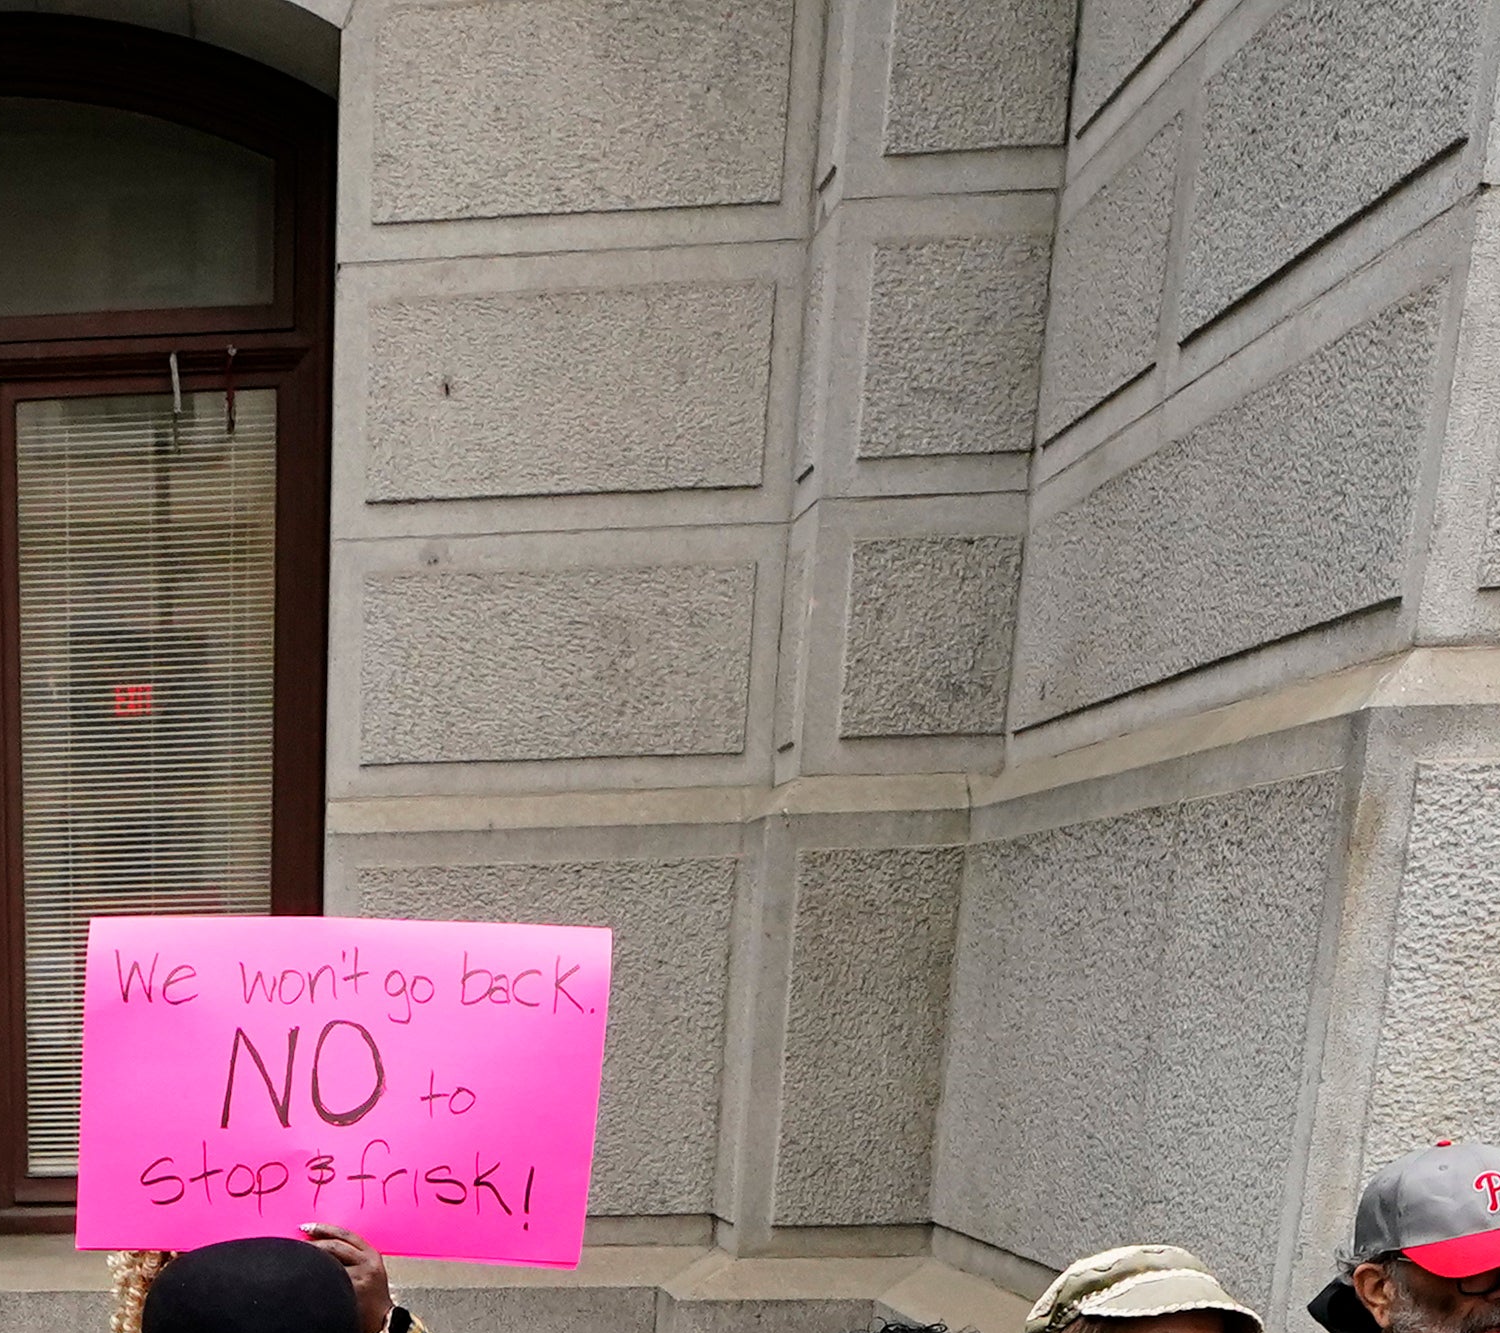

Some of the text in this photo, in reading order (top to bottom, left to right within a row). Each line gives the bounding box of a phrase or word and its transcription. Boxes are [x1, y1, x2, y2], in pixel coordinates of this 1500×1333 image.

[115, 949, 199, 1006] We
[239, 946, 368, 1006] won't
[383, 965, 436, 1024] go
[220, 1019, 476, 1130] NO to
[140, 1141, 289, 1218] stop
[347, 1138, 535, 1231] frisk!
